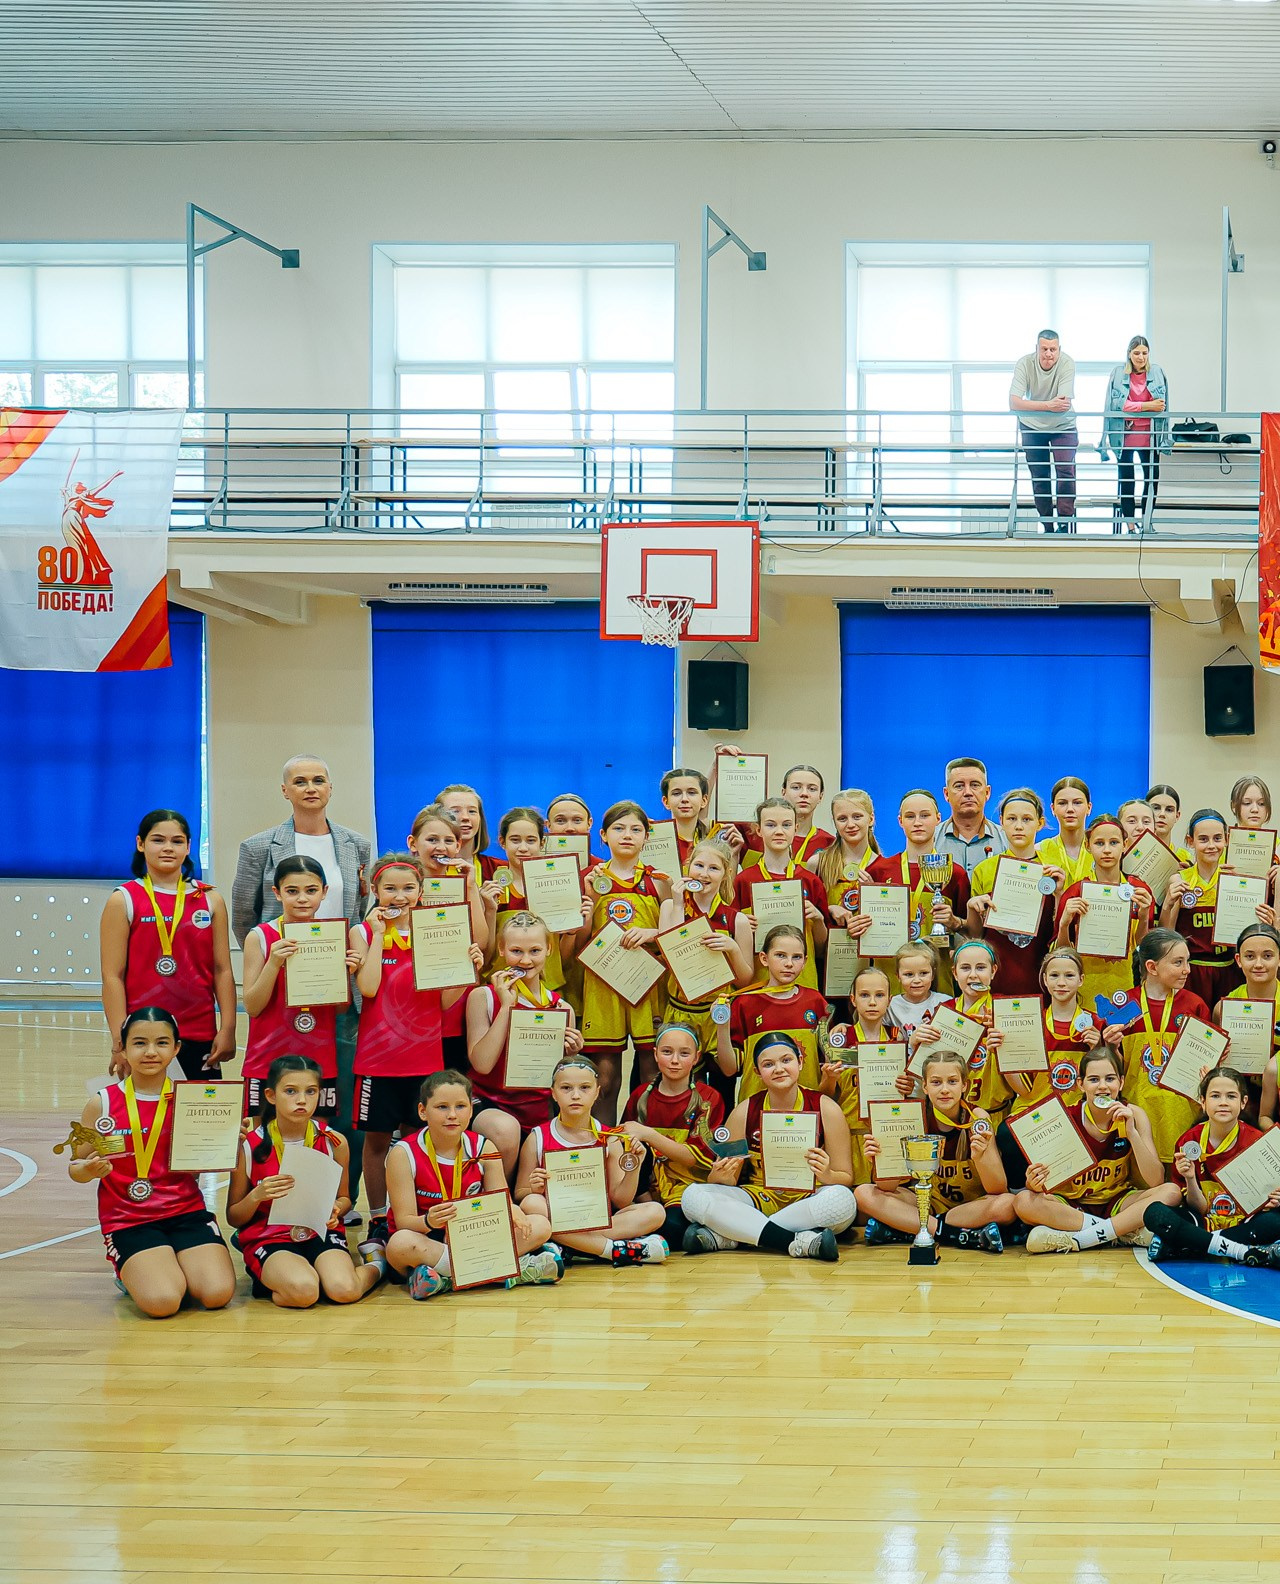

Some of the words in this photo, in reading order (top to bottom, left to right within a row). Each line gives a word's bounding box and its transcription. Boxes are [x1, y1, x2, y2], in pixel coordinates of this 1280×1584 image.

[38, 546, 79, 584] 80
[38, 592, 114, 615] ПОБЕДА!
[641, 843, 670, 852] ИПЛОМ
[1235, 848, 1266, 856] ДИПЛОМ
[534, 878, 571, 888] ДИПЛОМ
[1004, 879, 1036, 890] ДИПЛОМ
[1226, 894, 1258, 904] ДИПЛОМ
[762, 902, 794, 910] ДИПЛОМ
[1090, 904, 1122, 912] ДИПЛОМ
[1192, 912, 1214, 928] СШ
[423, 930, 462, 940] ДИПЛОМ
[675, 942, 702, 958] ДИПЛО
[834, 948, 858, 956] ДИПЛО
[600, 946, 621, 970] ДИПЛО
[1001, 1020, 1034, 1028] ДИПЛОМ
[1230, 1022, 1264, 1030] ДИПЛОМ
[518, 1032, 556, 1040] ДИПЛОМ
[1186, 1040, 1215, 1060] ДИПЛОМ
[866, 1064, 899, 1072] ДИПЛОМ
[250, 1078, 260, 1106] ИМПУ
[319, 1088, 336, 1107] 15
[186, 1108, 231, 1117] ДИПЛОМ
[880, 1124, 916, 1132] ДИПЛОМ
[1030, 1122, 1063, 1145] ДИПЛОМ
[556, 1172, 596, 1182] ДИПЛОМ
[963, 1166, 972, 1180] 5
[416, 1189, 442, 1198] ИМПУЛЬ
[458, 1218, 500, 1234] ДИПЛОМ
